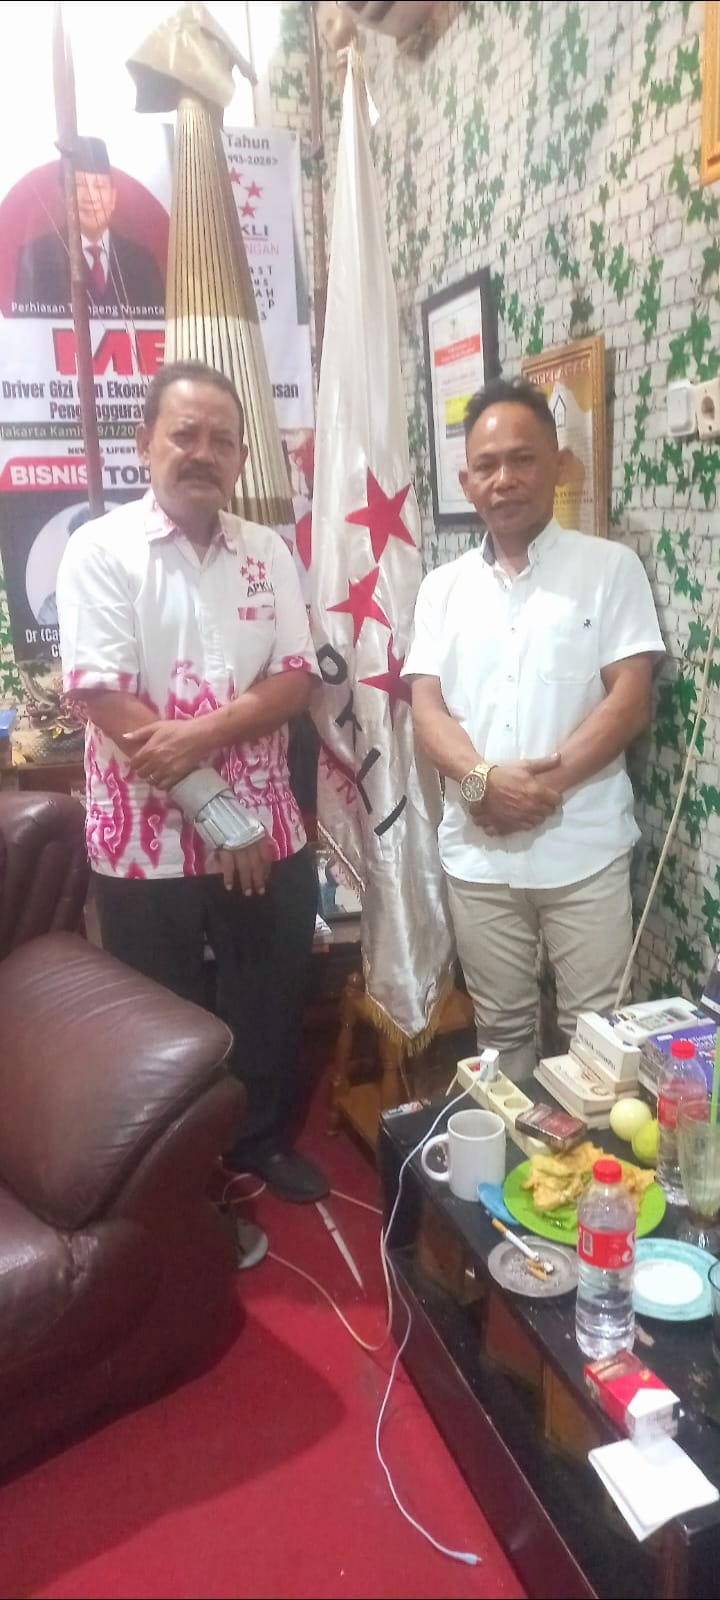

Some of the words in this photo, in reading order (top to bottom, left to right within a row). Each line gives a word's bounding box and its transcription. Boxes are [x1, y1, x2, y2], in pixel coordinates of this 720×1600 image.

[227, 134, 270, 149] Tahun
[11, 302, 65, 313] Perhiasan
[2, 380, 45, 399] Driver
[49, 381, 73, 399] Gizi
[25, 629, 37, 644] Dr
